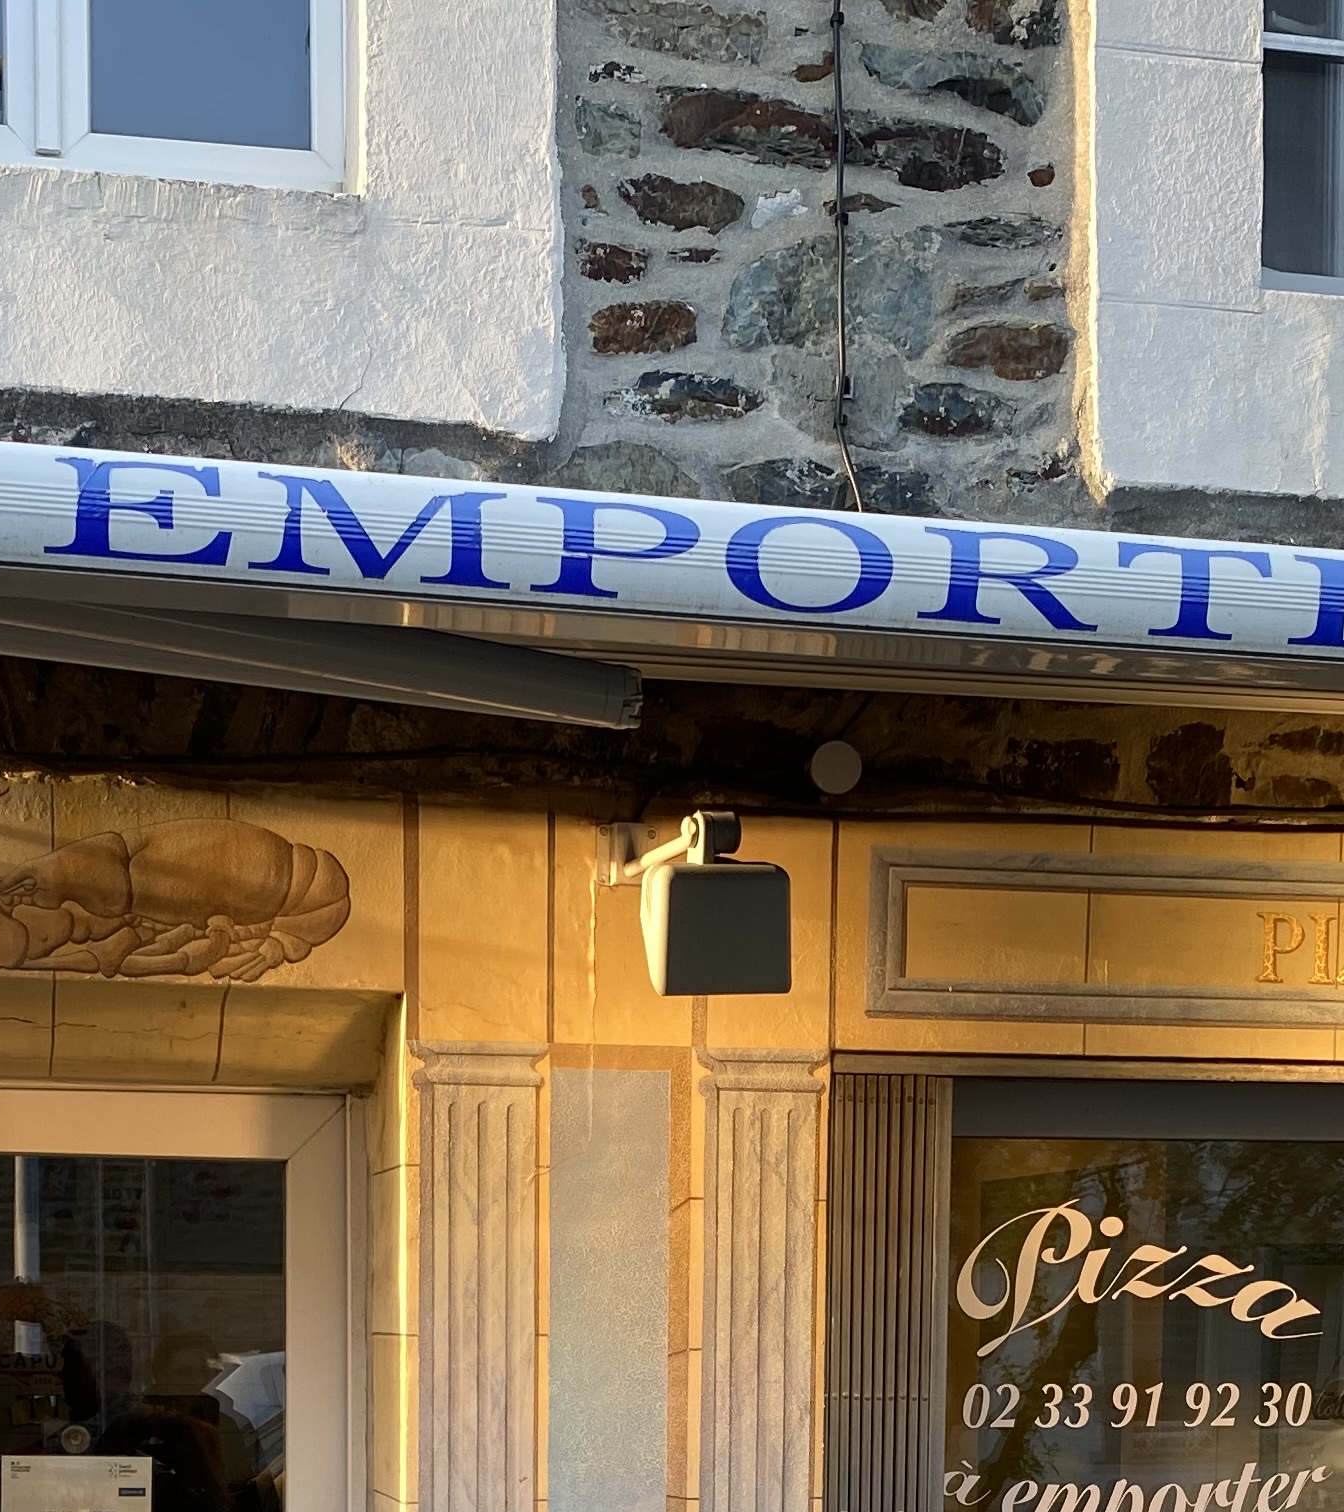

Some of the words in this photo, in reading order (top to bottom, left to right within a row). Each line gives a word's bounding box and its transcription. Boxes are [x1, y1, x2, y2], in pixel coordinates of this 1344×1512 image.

[956, 1198, 1323, 1358] Pizza
[962, 1383, 1020, 1429] 02
[1034, 1383, 1093, 1429] 33
[1110, 1382, 1165, 1429] 91
[1183, 1382, 1241, 1428] 92
[1254, 1382, 1312, 1428] 30
[944, 1460, 992, 1507] à
